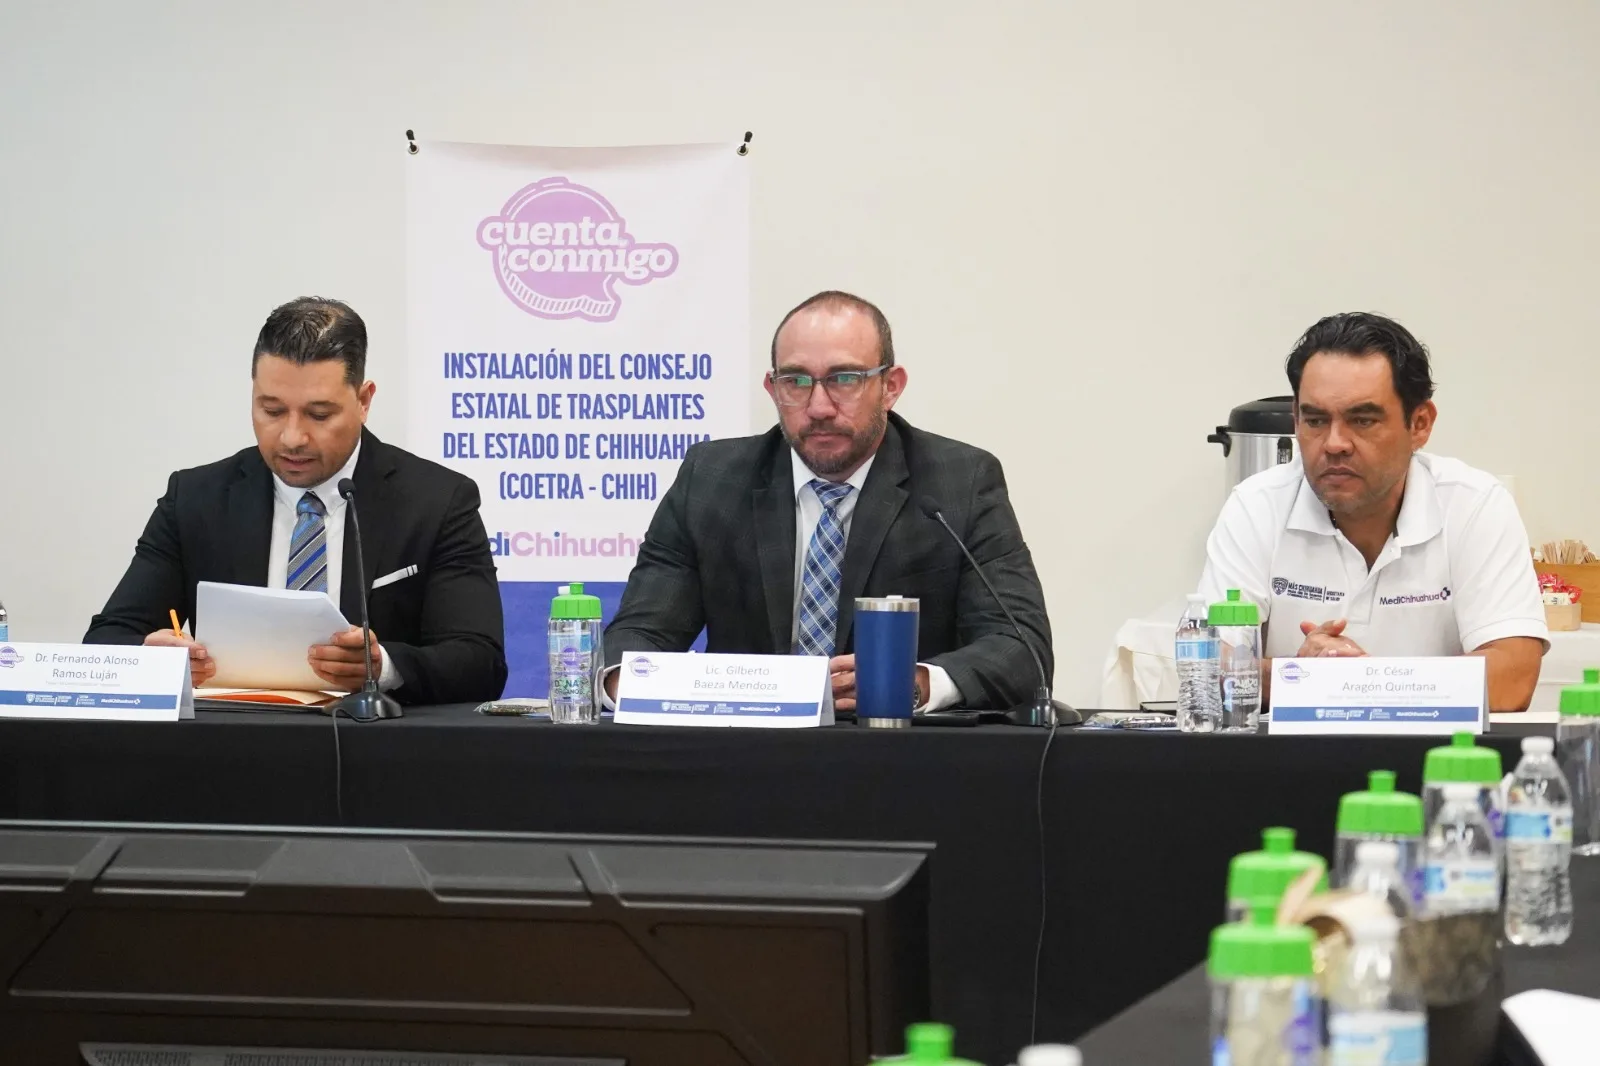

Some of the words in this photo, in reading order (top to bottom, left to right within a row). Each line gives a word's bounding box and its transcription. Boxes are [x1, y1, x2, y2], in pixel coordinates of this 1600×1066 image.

[482, 216, 620, 246] cuenta
[507, 249, 673, 280] conmigo
[444, 348, 573, 379] INSTALACIÓN
[579, 353, 615, 380] DEL
[620, 353, 712, 380] CONSEJO
[452, 393, 531, 419] ESTATAL
[537, 393, 562, 419] DE
[566, 393, 705, 420] TRASPLANTES
[443, 432, 480, 459] DEL
[485, 432, 559, 459] ESTADO
[566, 433, 590, 459] DE
[596, 433, 711, 459] CHIHUAH
[500, 472, 584, 500] (COETRA
[602, 472, 657, 500] CHIH)
[1380, 593, 1440, 605] MediChihuahua
[35, 653, 48, 662] Dr.
[52, 653, 101, 665] Fernando
[104, 654, 139, 666] Alonso
[52, 668, 87, 679] Ramos
[90, 669, 118, 682] Luján
[706, 665, 722, 675] Lic.
[726, 665, 770, 676] Gilberto
[1366, 667, 1380, 676] Dr.
[1384, 666, 1414, 676] César
[694, 679, 725, 690] Baeza
[728, 680, 778, 691] Mendoza
[1342, 681, 1382, 694] Aragón
[1385, 681, 1436, 692] Quintana
